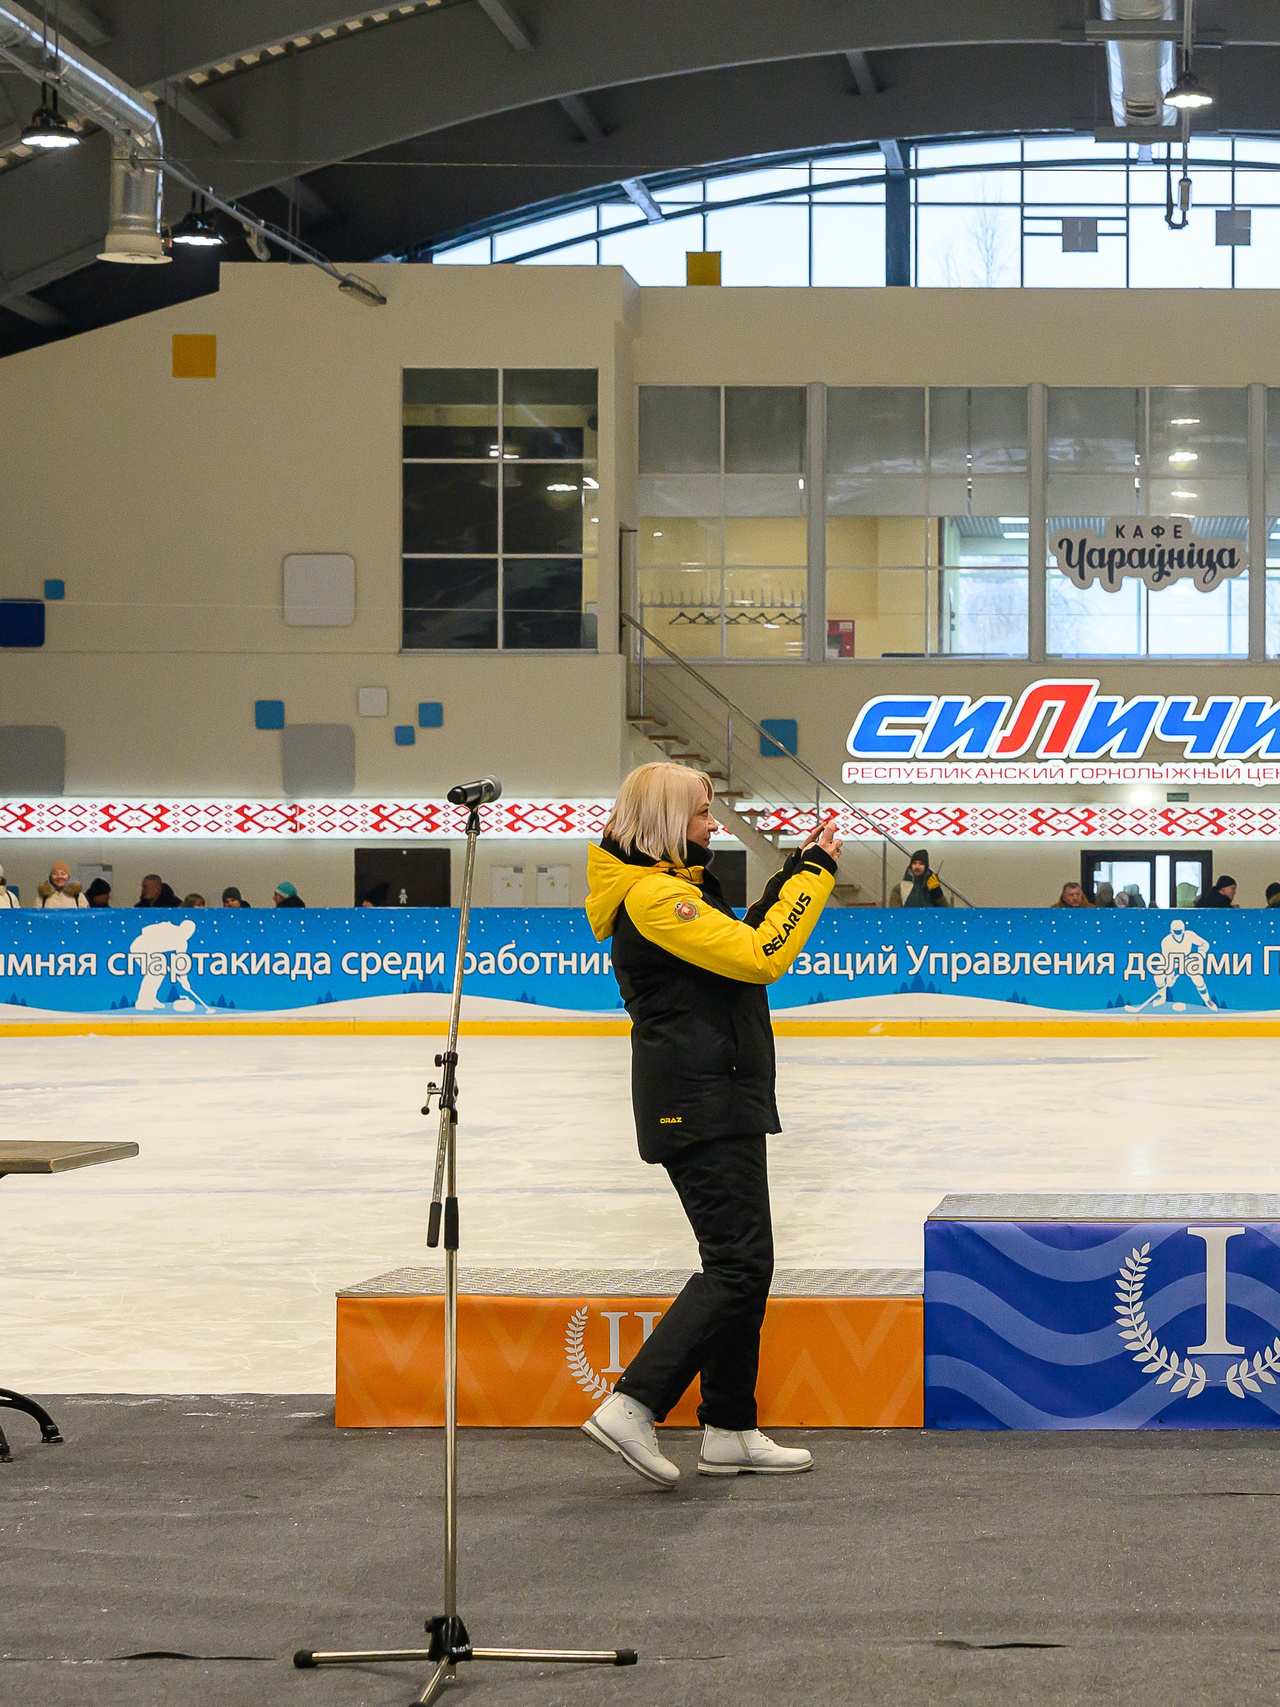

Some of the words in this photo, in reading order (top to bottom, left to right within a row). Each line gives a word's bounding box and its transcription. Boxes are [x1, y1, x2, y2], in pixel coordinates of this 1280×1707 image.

[1115, 524, 1183, 539] КАФЕ
[1058, 537, 1240, 585] Чараўніца
[847, 765, 1064, 779] РЕСПУБЛИКАНСКИЙ
[1069, 764, 1241, 780] ГОРНОЛЫЖНЫЙ
[762, 892, 812, 957] BELARUS
[0, 952, 97, 977] мняя
[107, 952, 331, 984] спартакиада
[341, 951, 446, 983] среди
[787, 945, 898, 981] заций
[906, 944, 1115, 983] Управления
[1123, 952, 1253, 981] делами
[660, 1116, 682, 1124] ORAZ
